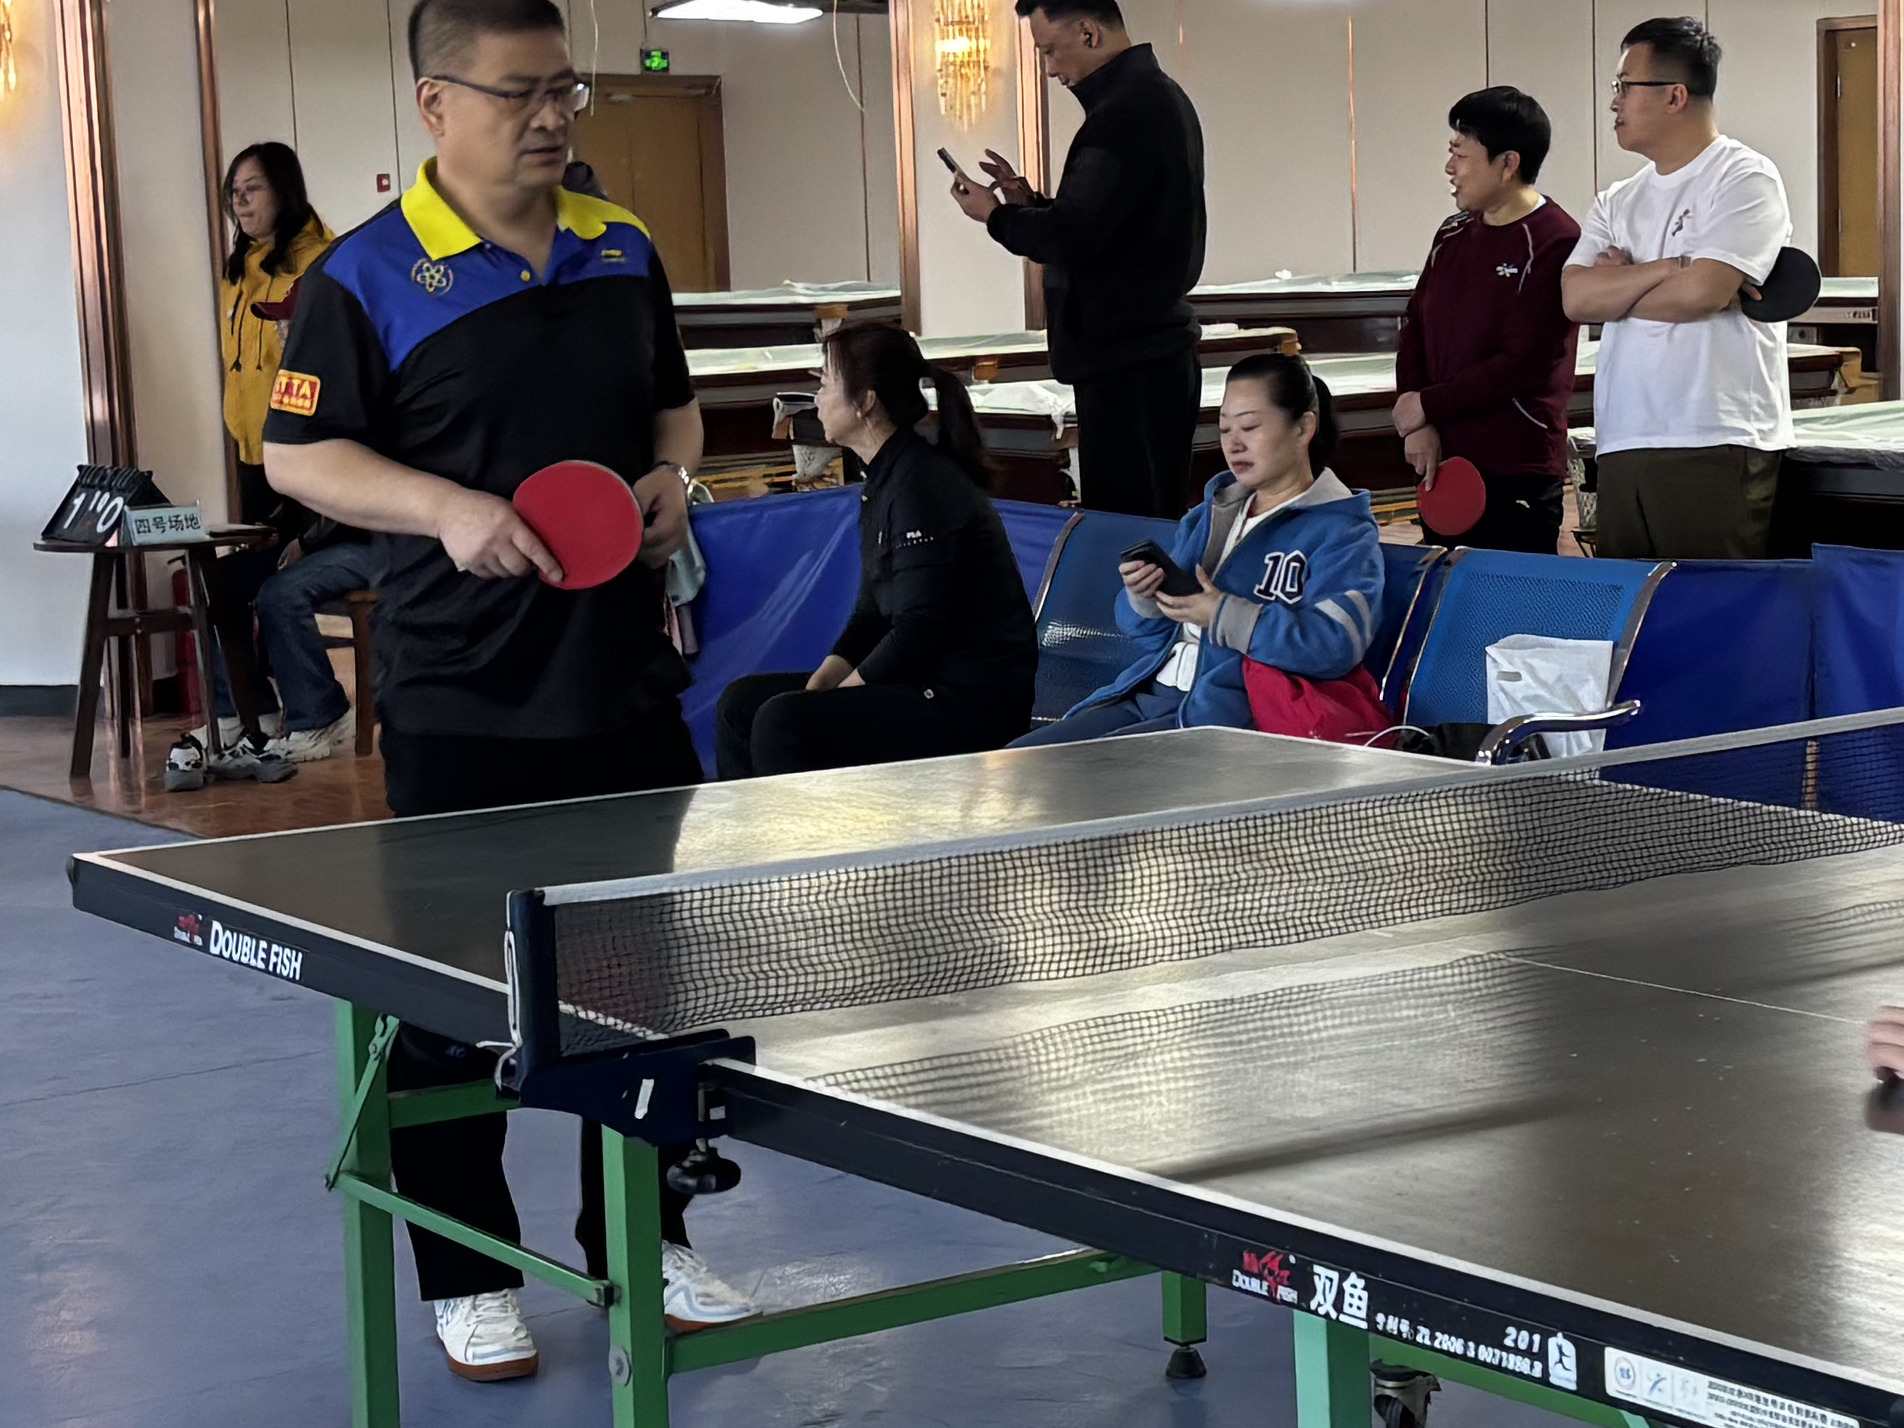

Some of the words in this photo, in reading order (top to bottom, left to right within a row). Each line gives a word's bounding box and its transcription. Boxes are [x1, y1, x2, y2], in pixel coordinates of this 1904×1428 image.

[134, 514, 201, 534] 四号场地
[1253, 549, 1308, 604] 10
[210, 921, 267, 969] DOUBLE
[269, 943, 302, 980] FISH
[1309, 1265, 1368, 1329] 双鱼
